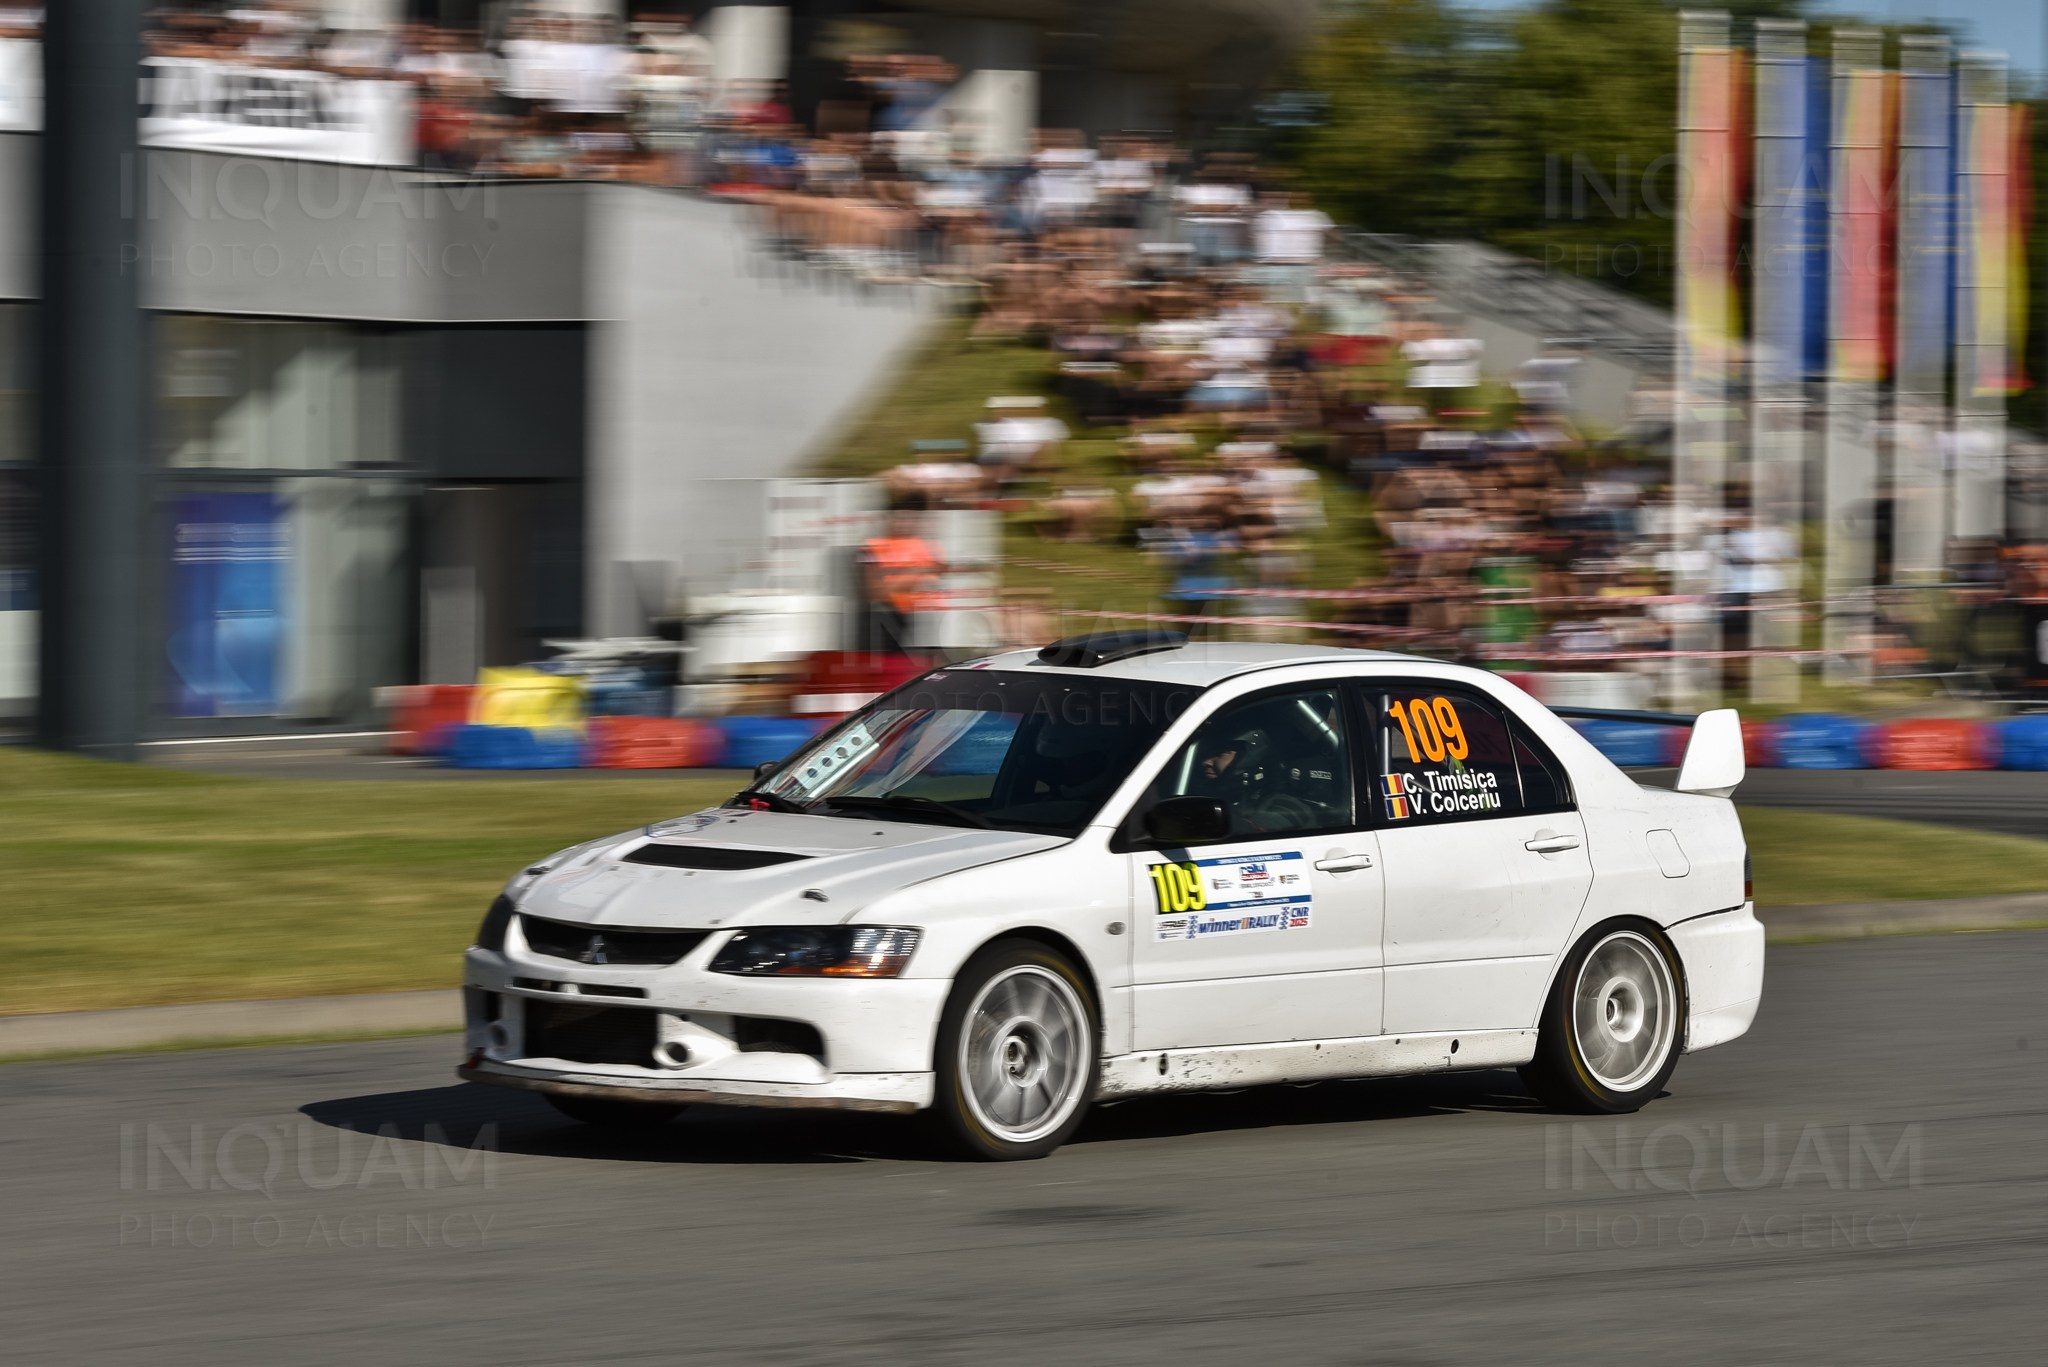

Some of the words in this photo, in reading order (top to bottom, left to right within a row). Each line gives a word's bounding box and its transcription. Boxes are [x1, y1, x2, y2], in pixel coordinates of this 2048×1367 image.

[1388, 697, 1468, 763] 109
[1403, 772, 1423, 794] C.
[1424, 768, 1498, 792] Timisica
[1409, 793, 1428, 815] V.
[1430, 789, 1501, 813] Colceriu
[1148, 862, 1207, 913] 109
[1249, 914, 1280, 929] RALLY
